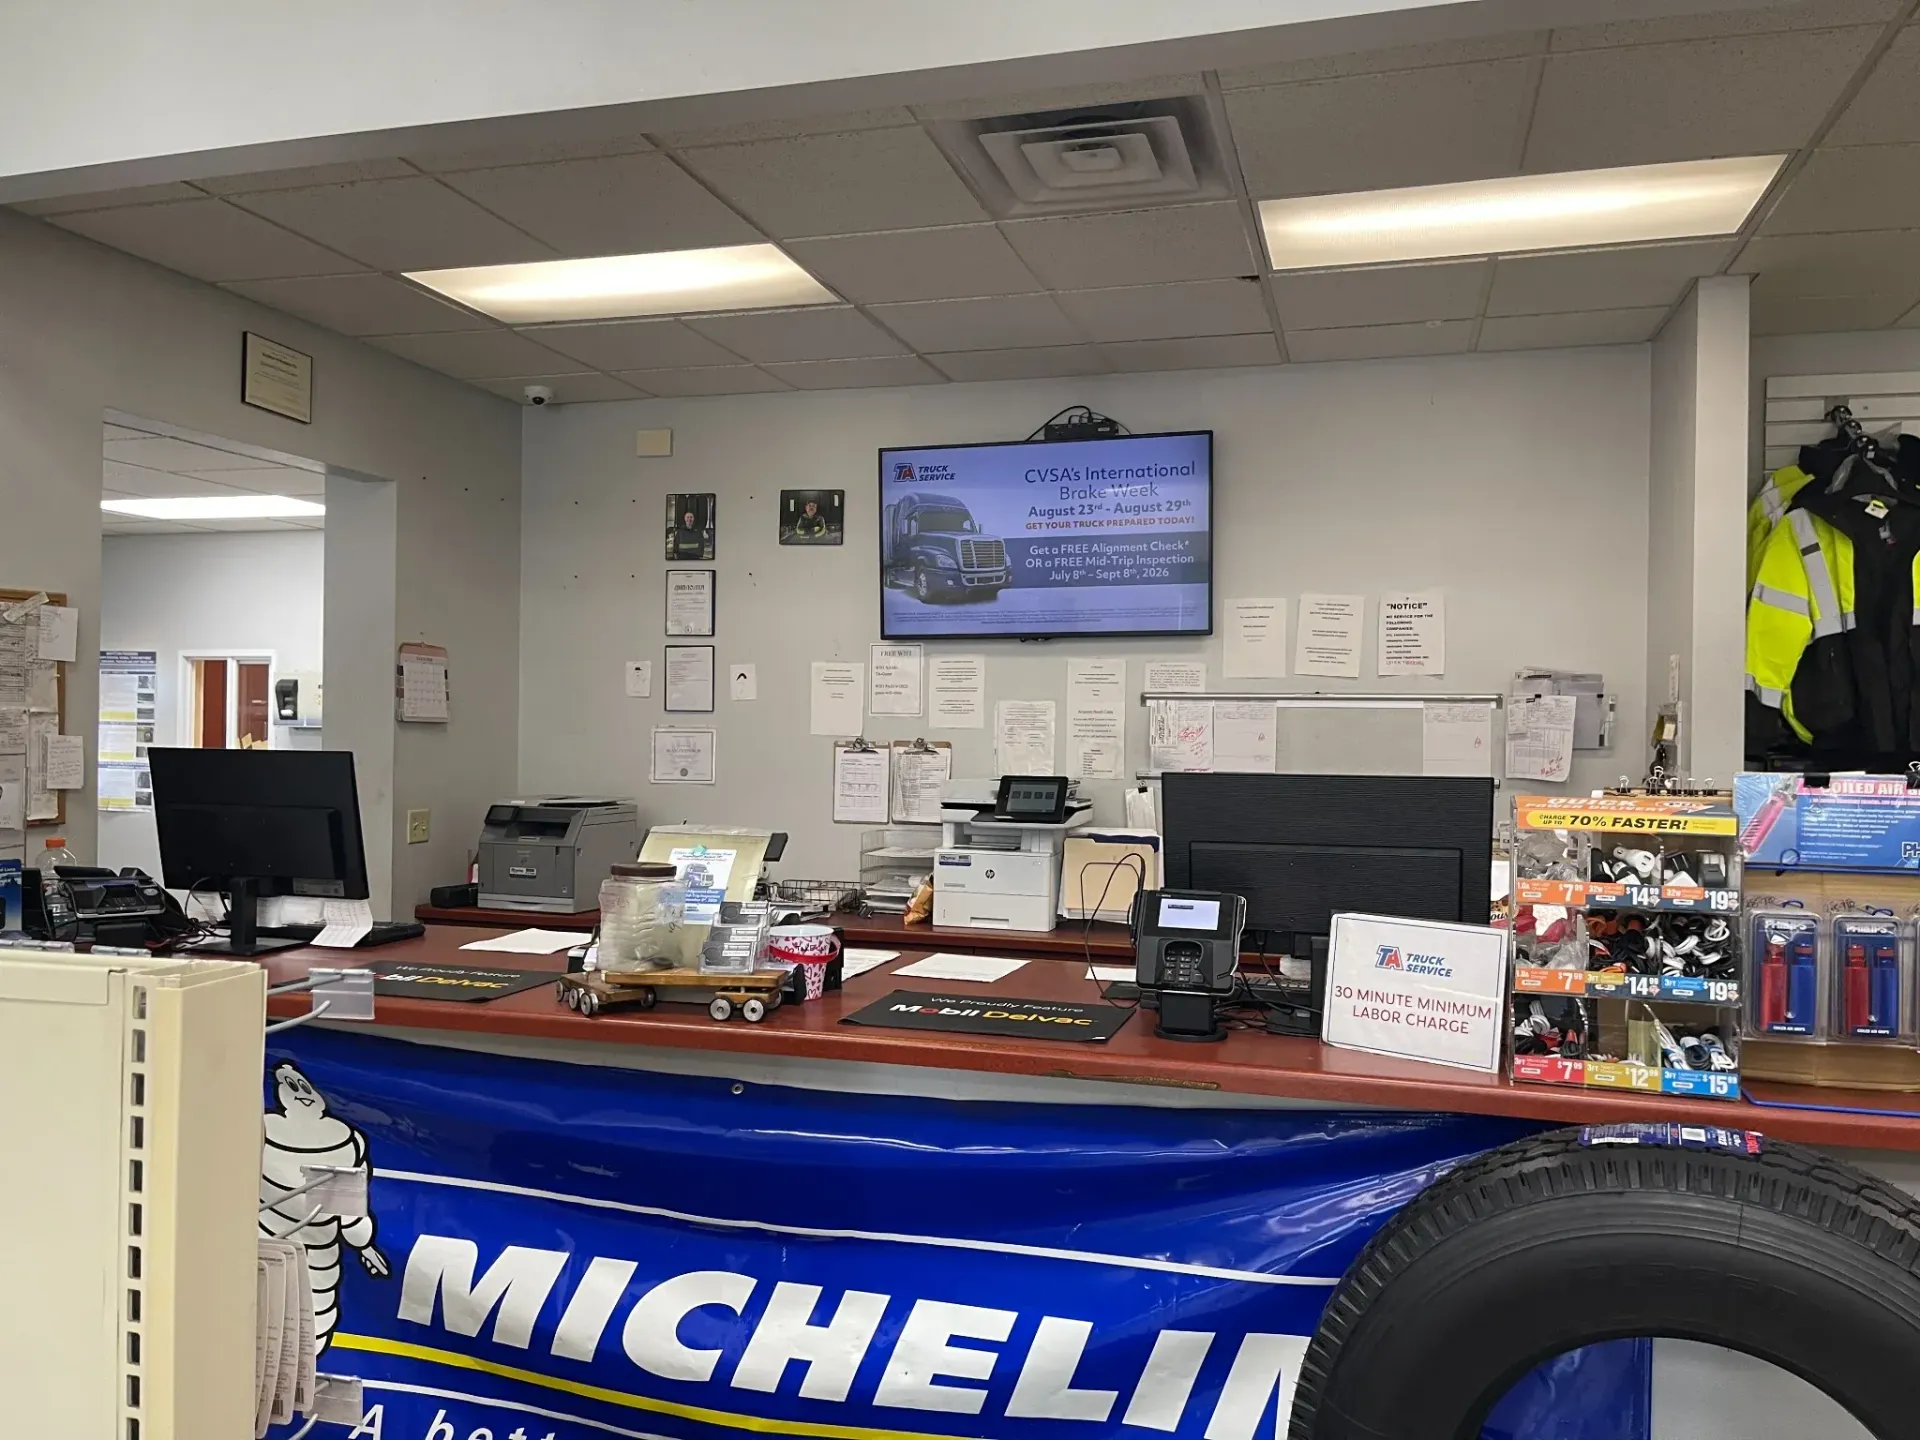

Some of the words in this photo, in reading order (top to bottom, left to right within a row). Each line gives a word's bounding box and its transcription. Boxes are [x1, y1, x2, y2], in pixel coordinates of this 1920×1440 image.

[918, 464, 950, 473] TRUCK
[1024, 467, 1081, 483] CVSA's
[1086, 460, 1196, 481] International
[918, 472, 956, 482] SERVICE
[1060, 484, 1107, 500] Brake
[1112, 482, 1159, 498] Week
[1028, 505, 1075, 519] August
[1078, 503, 1103, 515] 23rd
[1114, 501, 1163, 517] August
[1166, 499, 1191, 512] 29th
[1025, 522, 1043, 530] GET
[1045, 521, 1071, 529] YOUR
[1073, 520, 1105, 528] TRUCK
[1106, 518, 1156, 527] PREPARED
[1157, 516, 1195, 525] TODAY!
[1029, 545, 1050, 555] Get
[1060, 543, 1089, 554] FREE
[1091, 541, 1148, 555] Alignment
[1025, 558, 1043, 568] OR
[1045, 560, 1052, 568] a
[1054, 557, 1083, 567] FREE
[1085, 555, 1135, 568] Mid-Trip
[1136, 553, 1195, 567] Inspection
[1049, 570, 1071, 582] July
[1072, 569, 1087, 580] 8th
[1096, 569, 1121, 581] Sept
[1142, 567, 1169, 578] 2026
[1822, 781, 1875, 795] OILED
[1877, 782, 1905, 796] AIR
[1569, 815, 1607, 827] 70%
[1611, 816, 1688, 830] FASTER!
[1375, 945, 1404, 971] TA
[1406, 953, 1445, 966] TRUCK
[1406, 964, 1453, 978] SERVICE
[416, 976, 508, 988] Delvac
[959, 999, 1020, 1009] Proudly
[1023, 1004, 1084, 1013] Feature
[1334, 985, 1353, 999] 30
[1357, 988, 1413, 1008] MINUTE
[1417, 997, 1492, 1020] MINIMUM
[889, 1004, 980, 1017] Mobil
[982, 1011, 1094, 1026] Delvac
[1352, 1005, 1401, 1024] LABOR
[1405, 1013, 1469, 1034] CHARGE
